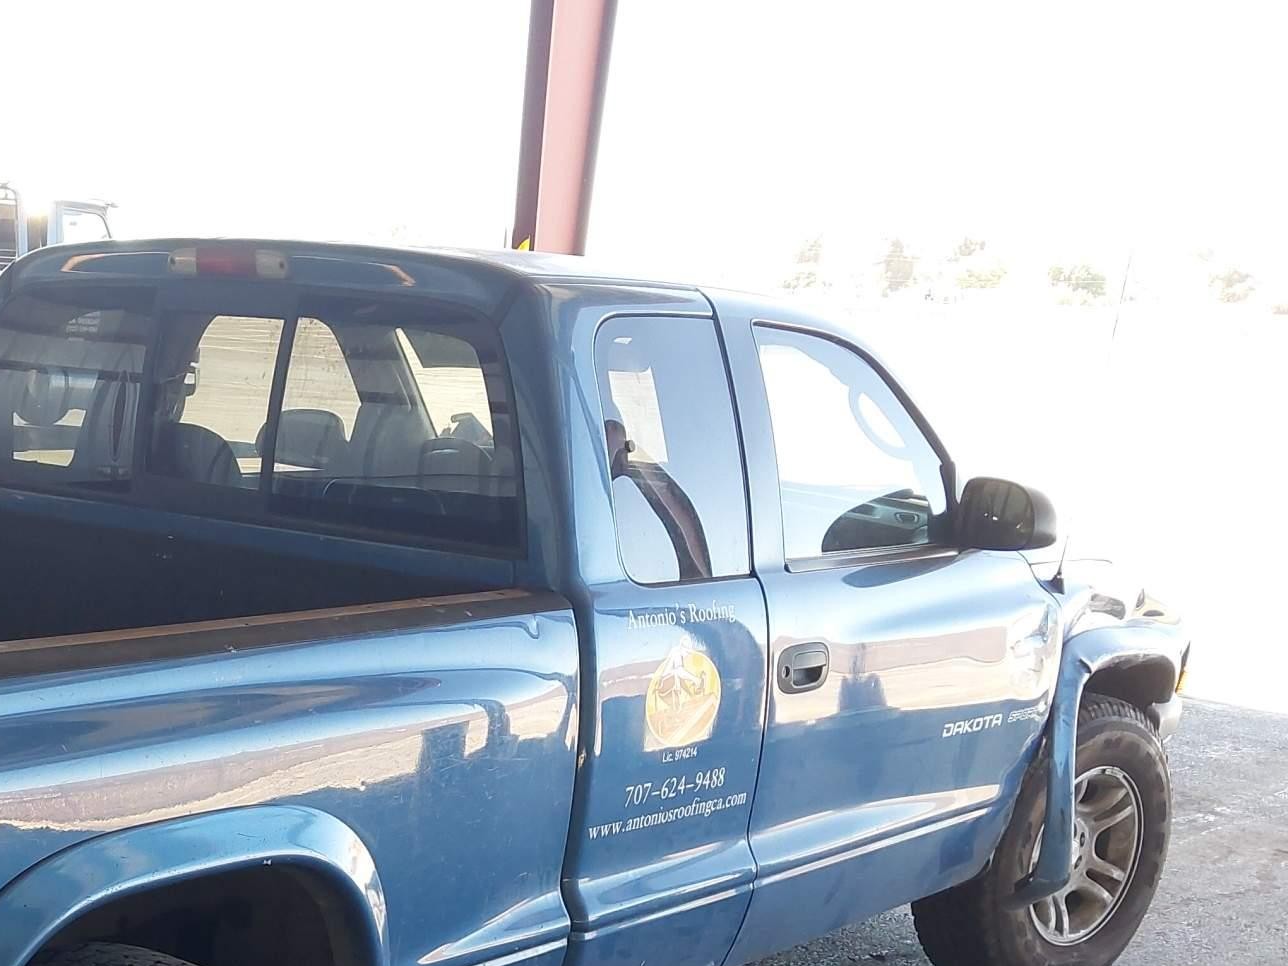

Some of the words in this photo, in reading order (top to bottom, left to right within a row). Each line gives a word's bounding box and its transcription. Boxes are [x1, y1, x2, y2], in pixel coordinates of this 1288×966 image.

[627, 602, 686, 630] Antonio's
[689, 600, 736, 623] Roofing
[942, 713, 1003, 738] DAKOTA
[675, 747, 697, 762] 974214
[624, 767, 726, 808] 707-624-9488
[588, 791, 747, 840] www.antoniosroofingca.com
